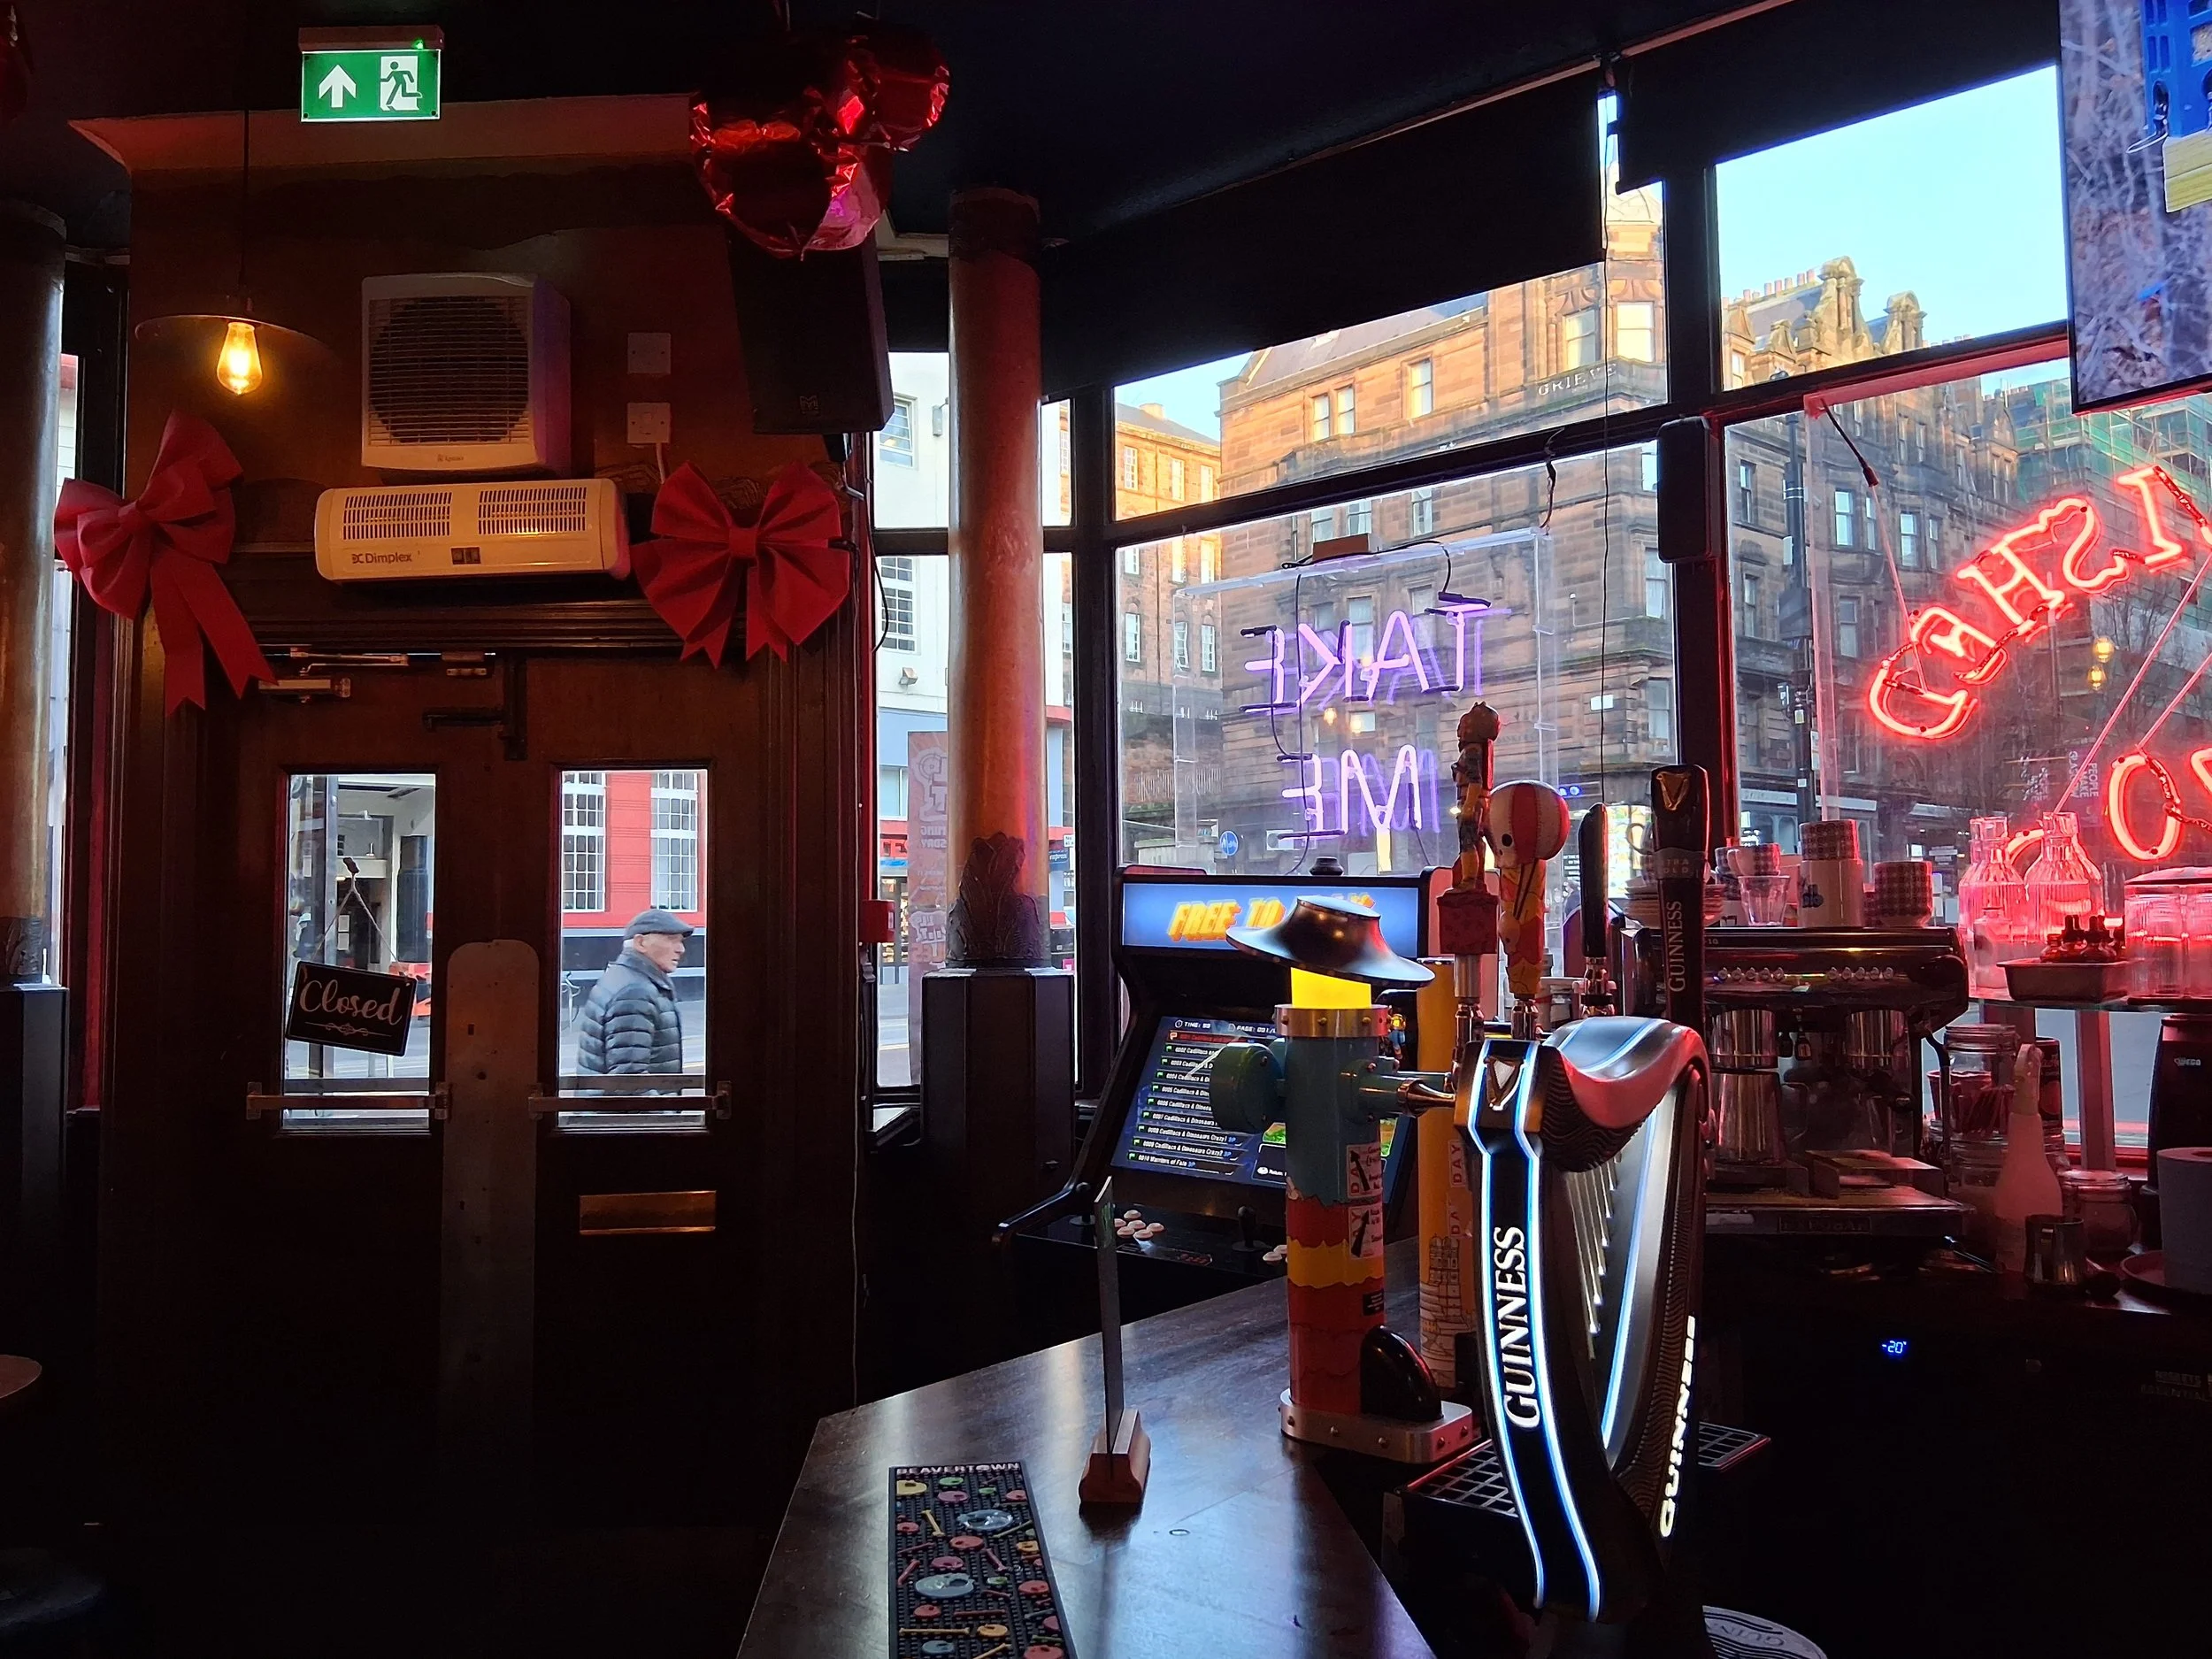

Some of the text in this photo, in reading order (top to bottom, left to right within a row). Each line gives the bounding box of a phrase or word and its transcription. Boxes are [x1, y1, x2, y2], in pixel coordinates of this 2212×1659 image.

[365, 551, 412, 564] Dimplex
[2088, 763, 2099, 797] PEOPLE
[1167, 897, 1241, 942] FREE
[1245, 895, 1287, 929] TO
[1666, 900, 1686, 993] GUINNESS
[299, 979, 403, 1026] Closed
[1451, 1143, 1463, 1184] DAY
[1494, 1225, 1540, 1429] GUINNESS
[896, 1463, 1021, 1475] BEAVERTOWN
